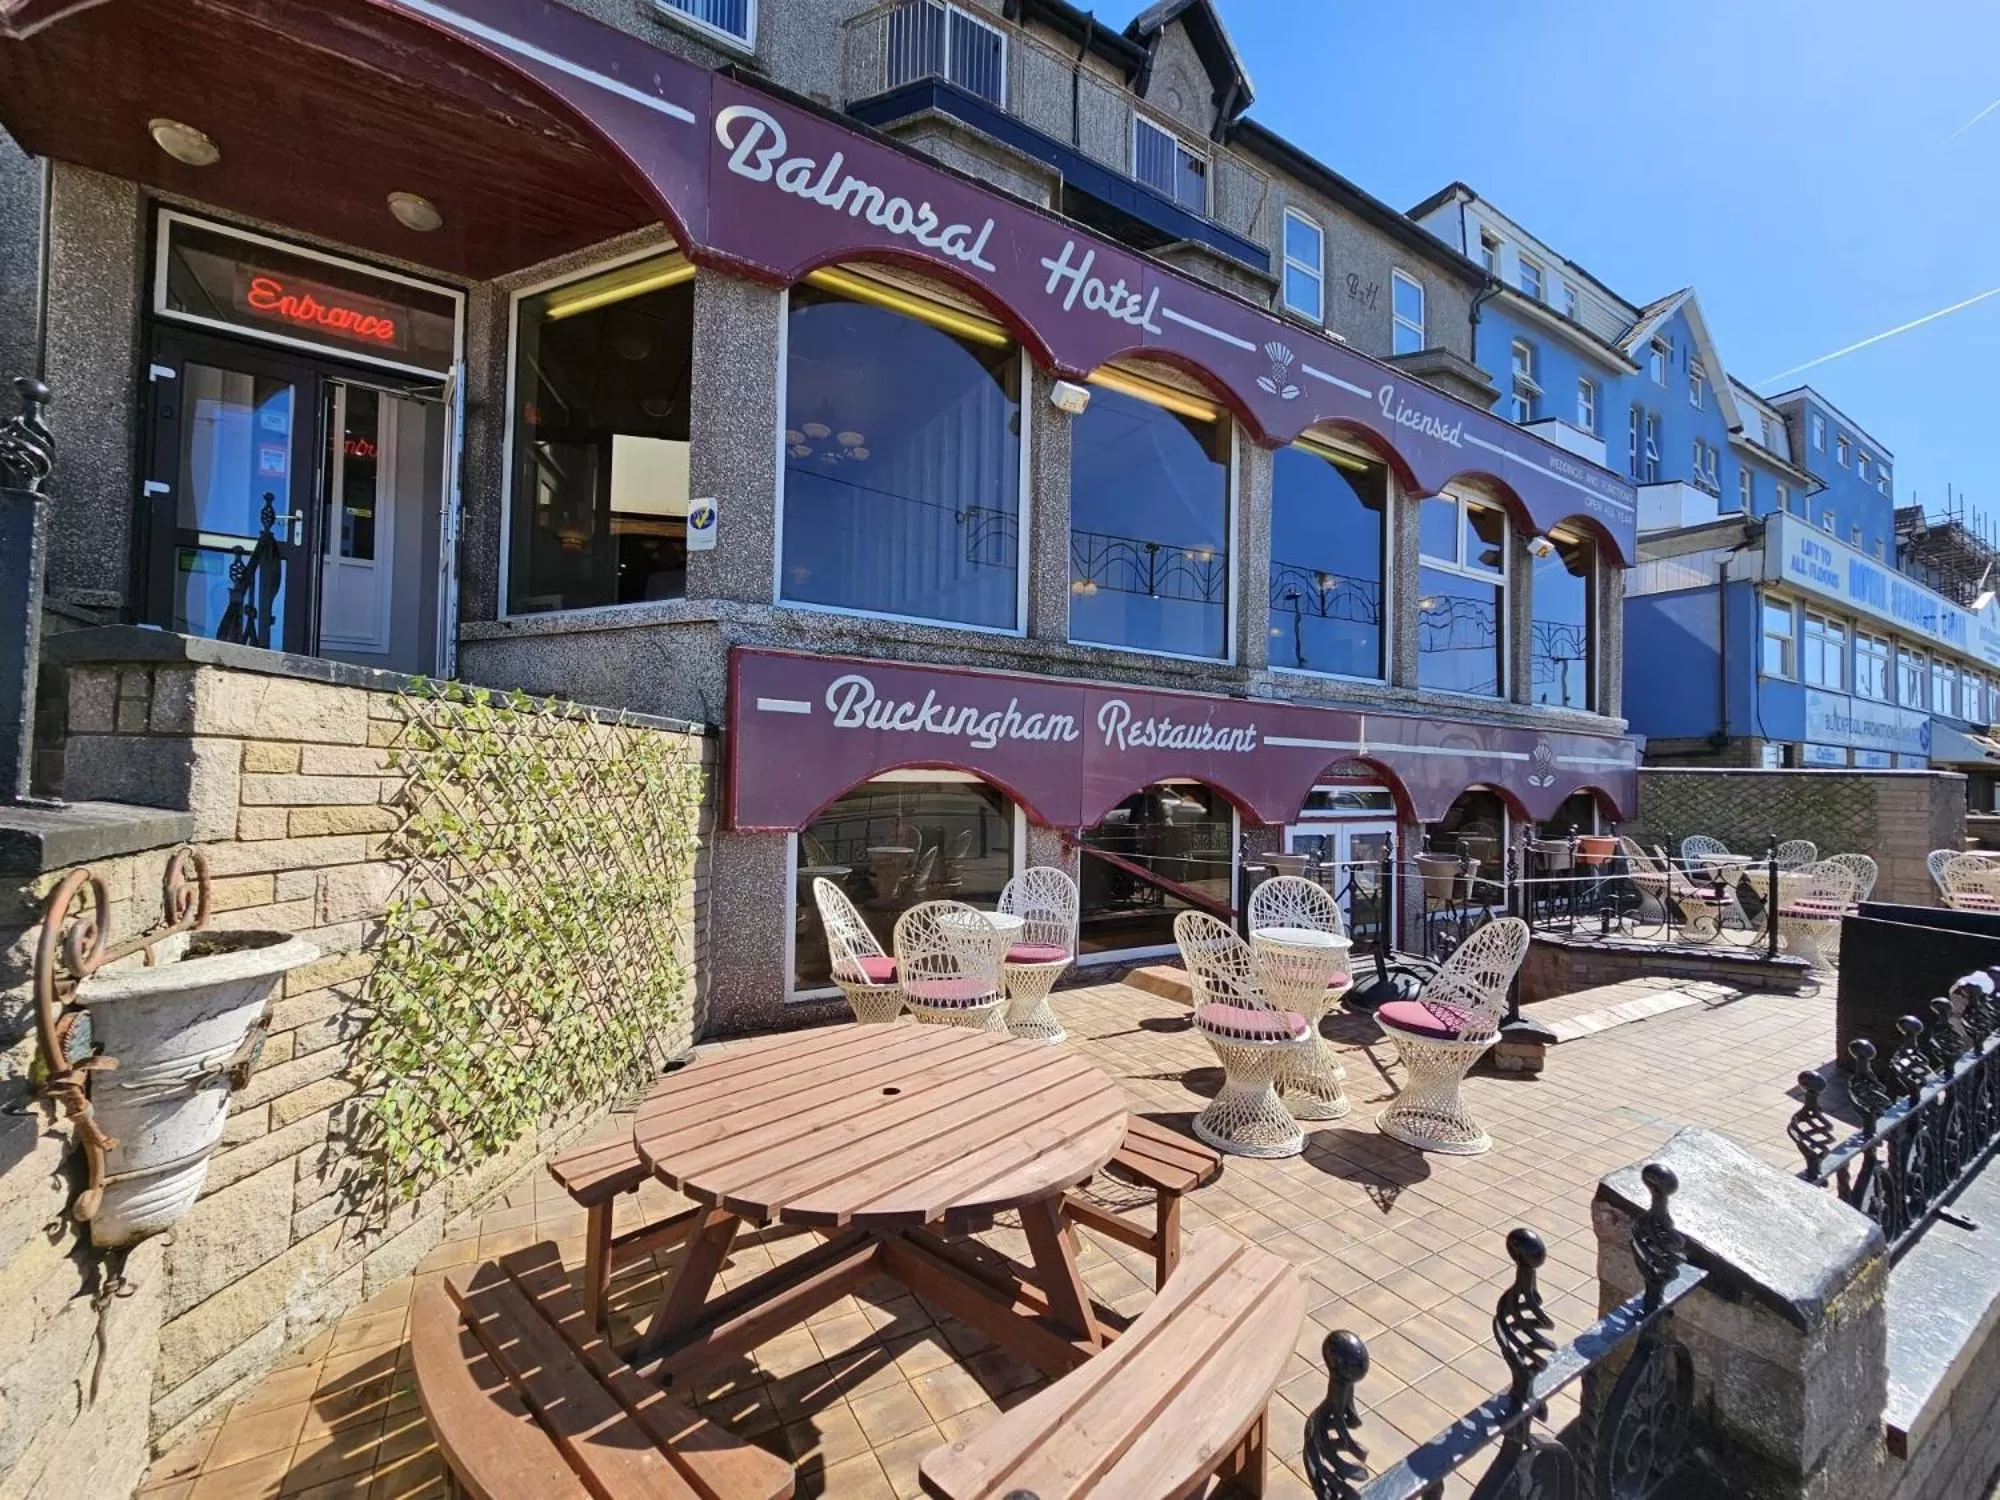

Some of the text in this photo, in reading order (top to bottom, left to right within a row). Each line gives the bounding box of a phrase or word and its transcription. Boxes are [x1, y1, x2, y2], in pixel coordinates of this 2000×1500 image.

[715, 105, 1162, 335] Balmoral Hotel
[247, 276, 396, 341] Entrance
[1378, 384, 1463, 449] Licensed
[1584, 497, 1602, 512] OPEN
[825, 674, 1258, 752] Buckingham Restaurant
